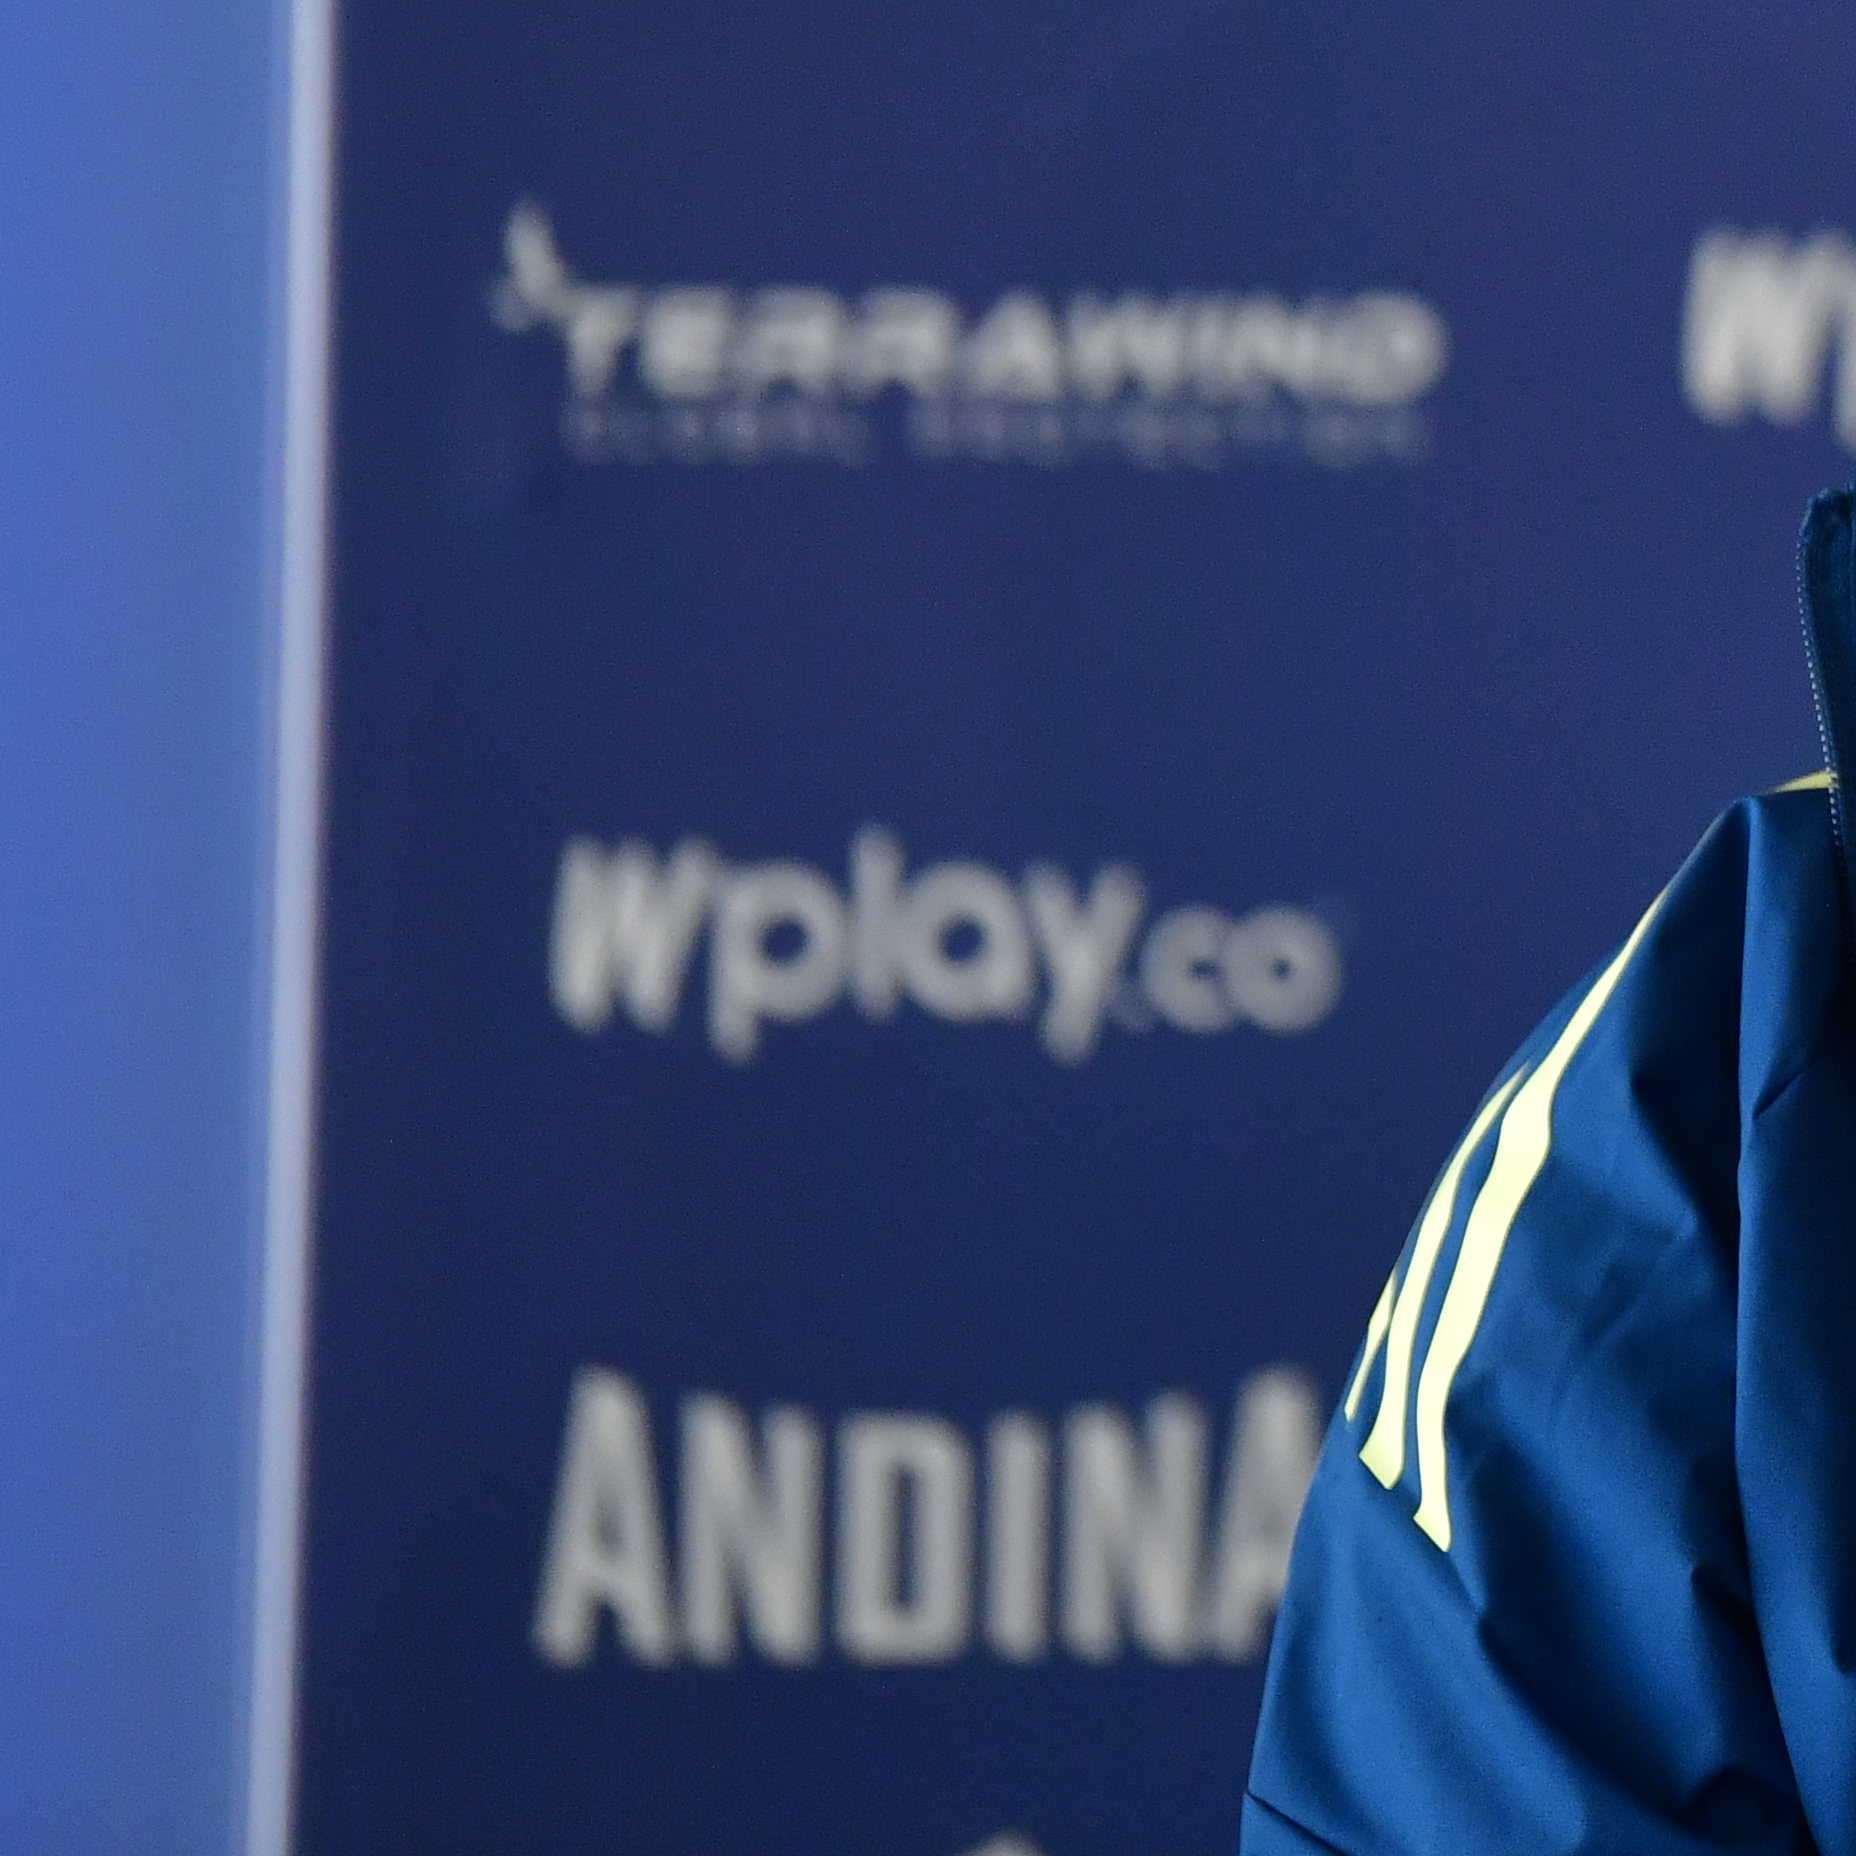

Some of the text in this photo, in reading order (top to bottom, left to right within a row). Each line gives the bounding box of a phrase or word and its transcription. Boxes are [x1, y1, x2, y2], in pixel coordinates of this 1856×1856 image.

[555, 280, 1447, 402] TERRAWIND
[548, 826, 1340, 1062] Wplay.co
[533, 1366, 1318, 1666] ANDINA
